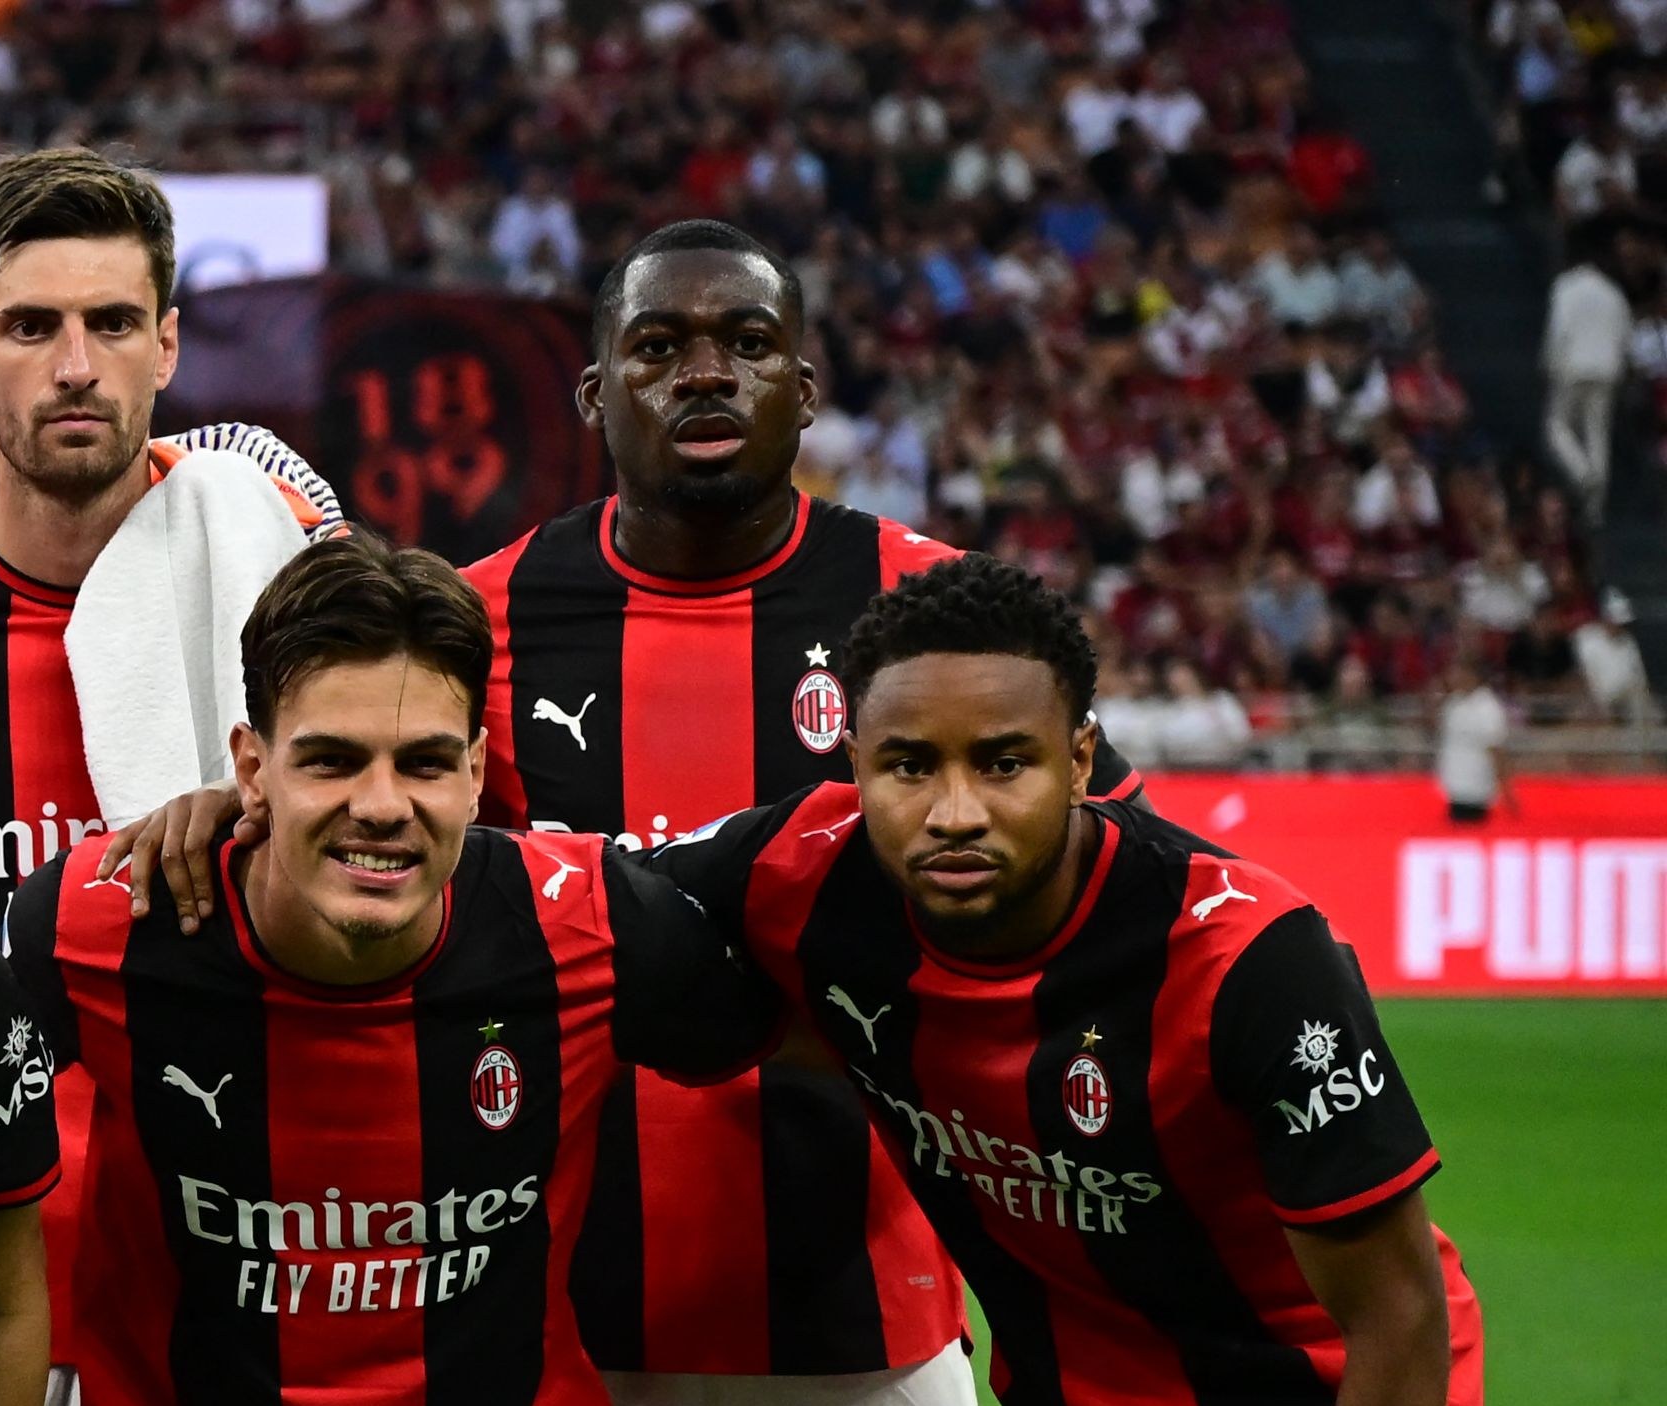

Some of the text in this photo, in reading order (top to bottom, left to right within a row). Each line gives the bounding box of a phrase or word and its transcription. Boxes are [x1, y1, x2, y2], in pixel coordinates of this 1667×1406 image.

[805, 676, 833, 691] ACM
[808, 733, 834, 743] 1899
[1397, 840, 1667, 978] PUM
[482, 1052, 510, 1071] ACM
[1073, 1061, 1101, 1079] ACM
[1273, 1049, 1385, 1135] MSC
[486, 1109, 511, 1121] 1899
[178, 1173, 539, 1251] Emirates
[237, 1244, 491, 1314] FLY BETTER
